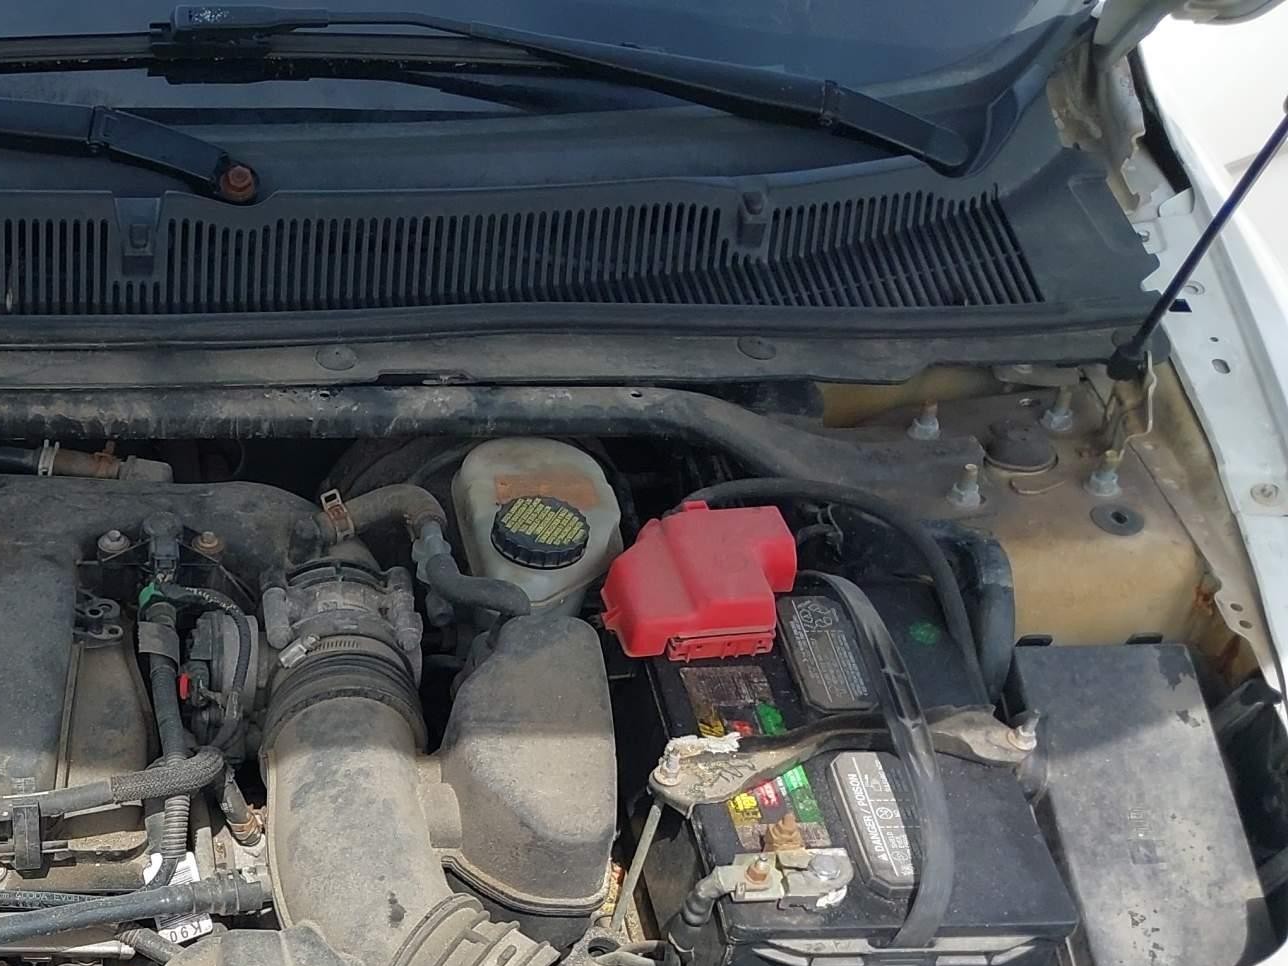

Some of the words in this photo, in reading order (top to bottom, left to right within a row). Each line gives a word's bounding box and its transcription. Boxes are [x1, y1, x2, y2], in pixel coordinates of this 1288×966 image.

[847, 773, 868, 807] POISON
[863, 815, 885, 852] DANGER
[169, 921, 202, 943] K90
